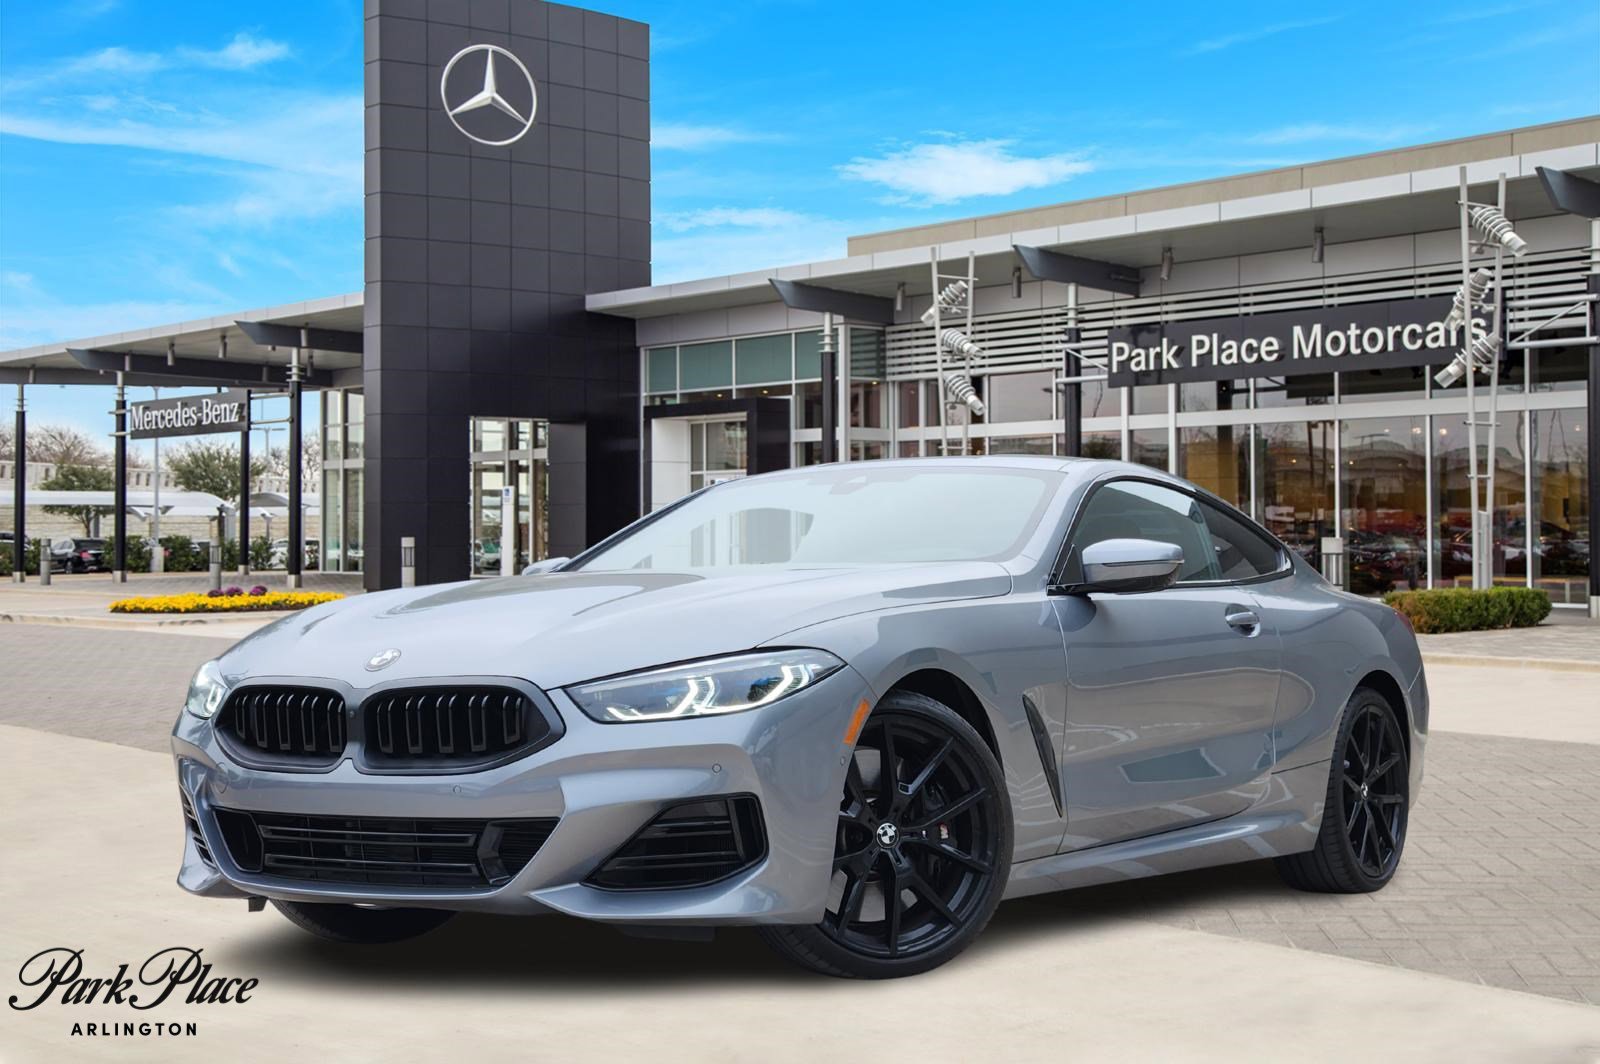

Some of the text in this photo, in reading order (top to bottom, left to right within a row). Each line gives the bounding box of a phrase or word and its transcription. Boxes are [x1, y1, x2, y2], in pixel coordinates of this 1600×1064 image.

[1112, 337, 1179, 373] Park
[1191, 333, 1279, 367] Place
[131, 399, 239, 430] Mercedes-Benz
